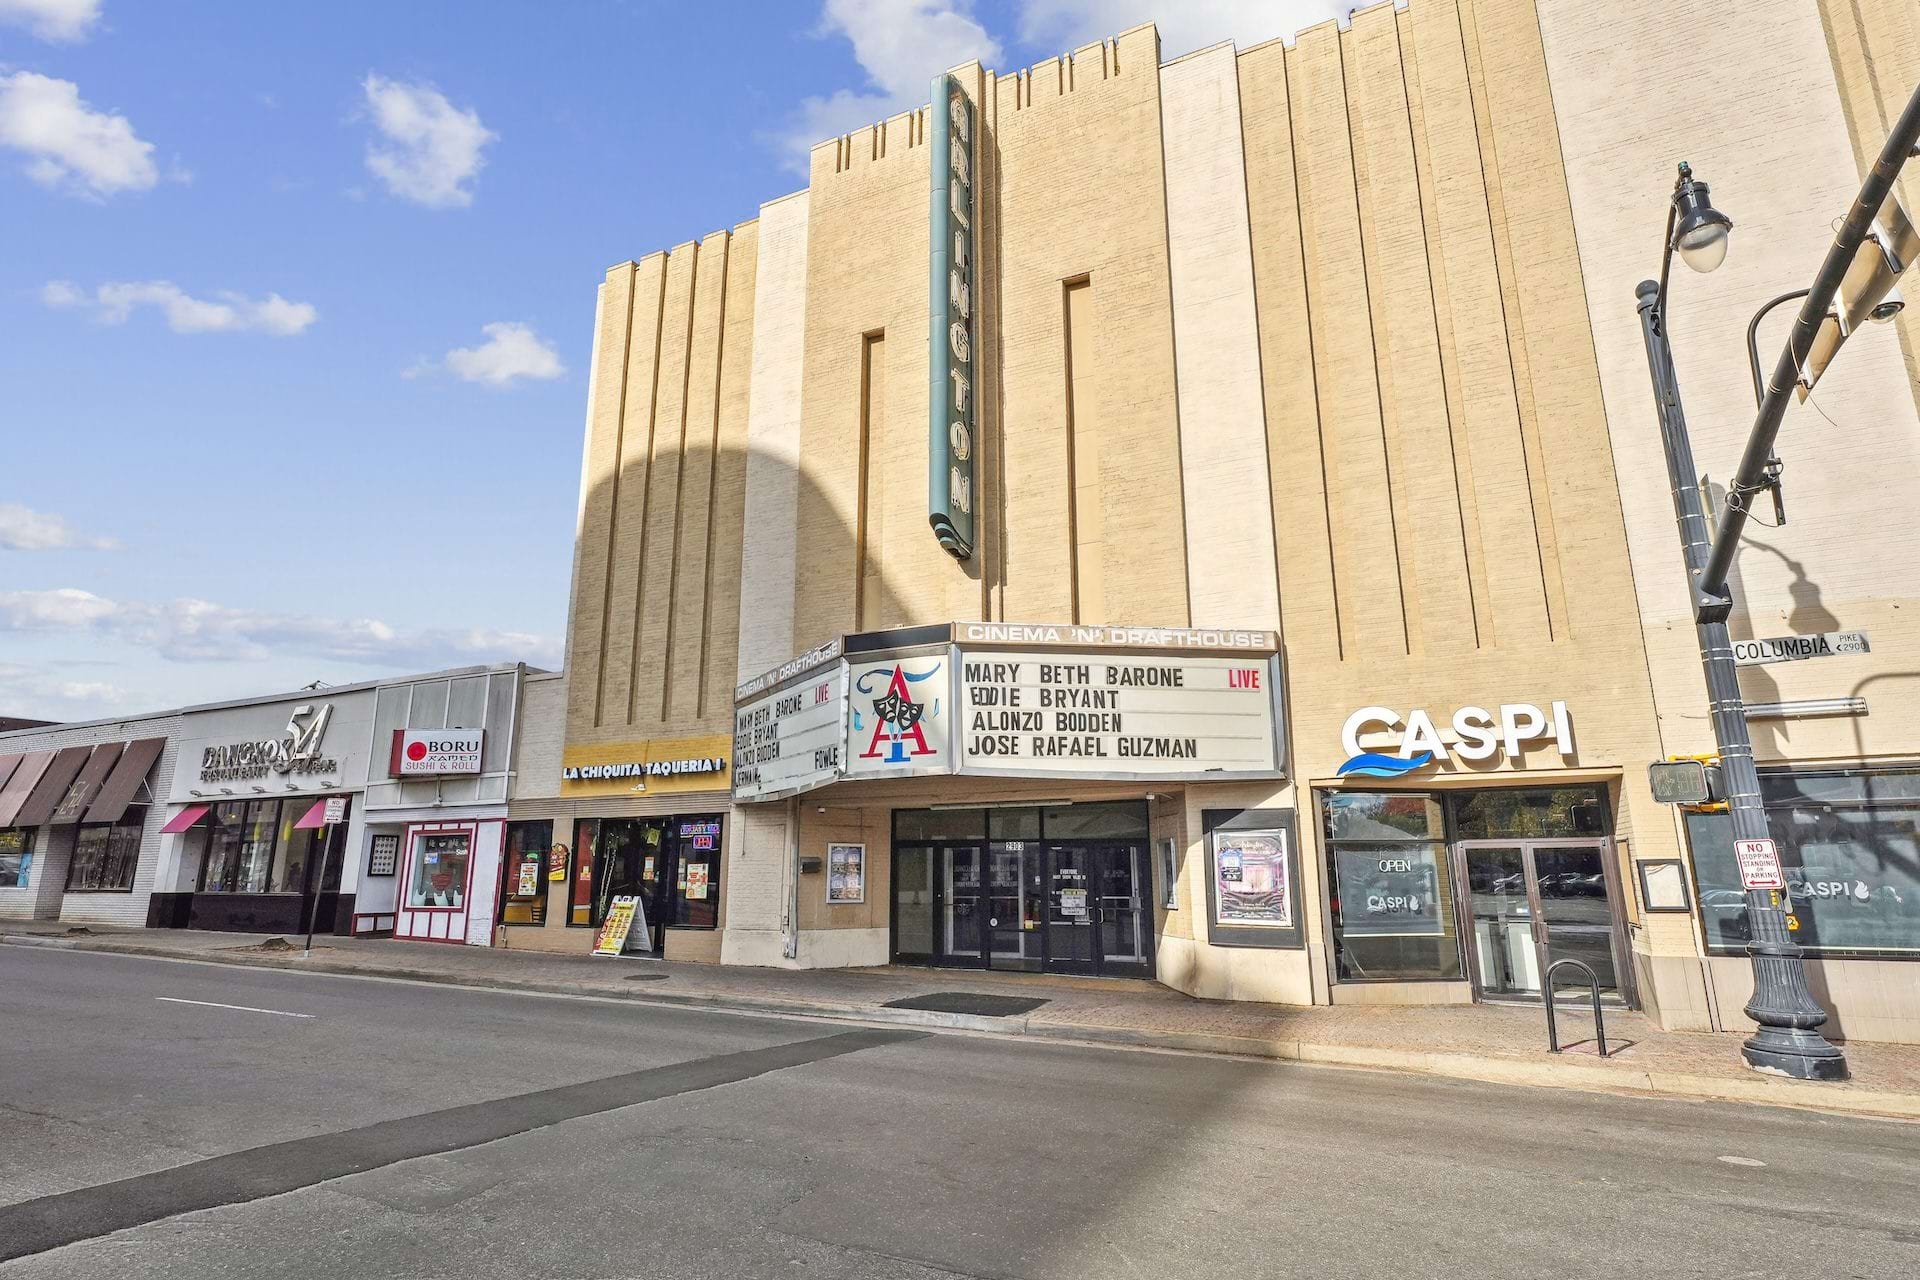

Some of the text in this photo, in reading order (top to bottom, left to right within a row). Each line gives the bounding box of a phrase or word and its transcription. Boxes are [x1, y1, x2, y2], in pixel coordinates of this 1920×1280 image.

[950, 98, 970, 514] ARLINGTON
[967, 626, 1060, 642] CINEMA
[1111, 630, 1265, 648] DRAFTHOUSE
[1839, 633, 1858, 642] PIKE
[1844, 642, 1866, 651] 2900
[1735, 637, 1831, 660] COLUMBIA
[737, 680, 765, 698] CINEMA
[780, 641, 838, 679] DRAFTHOUSE
[965, 663, 1260, 689] MARY BETH BARONE LIVE
[739, 683, 829, 731] MARY BETH BARONE LIVE
[970, 686, 1119, 709] EDDIE BRYANT
[972, 711, 1122, 733] ALONZO BODDEN
[1341, 700, 1573, 760] CASPI
[275, 703, 334, 772] 54
[429, 741, 479, 752] BORU
[737, 723, 778, 750] EDDIE BRYANT
[968, 735, 1197, 758] JOSE RAFAEL GUZMAN
[757, 741, 780, 763] BODDEN
[405, 761, 475, 770] SUSHI & ROLL
[563, 767, 579, 779] LA
[581, 763, 641, 779] CHIQUITA
[645, 758, 713, 776] TAQUERIA
[1005, 842, 1024, 851] 2903
[1741, 853, 1774, 861] STOPPING
[1747, 843, 1763, 852] NO
[1379, 859, 1411, 872] OPEN
[1743, 860, 1776, 868] STANDING
[1787, 881, 1850, 900] CASPI
[1368, 895, 1407, 909] CASPI
